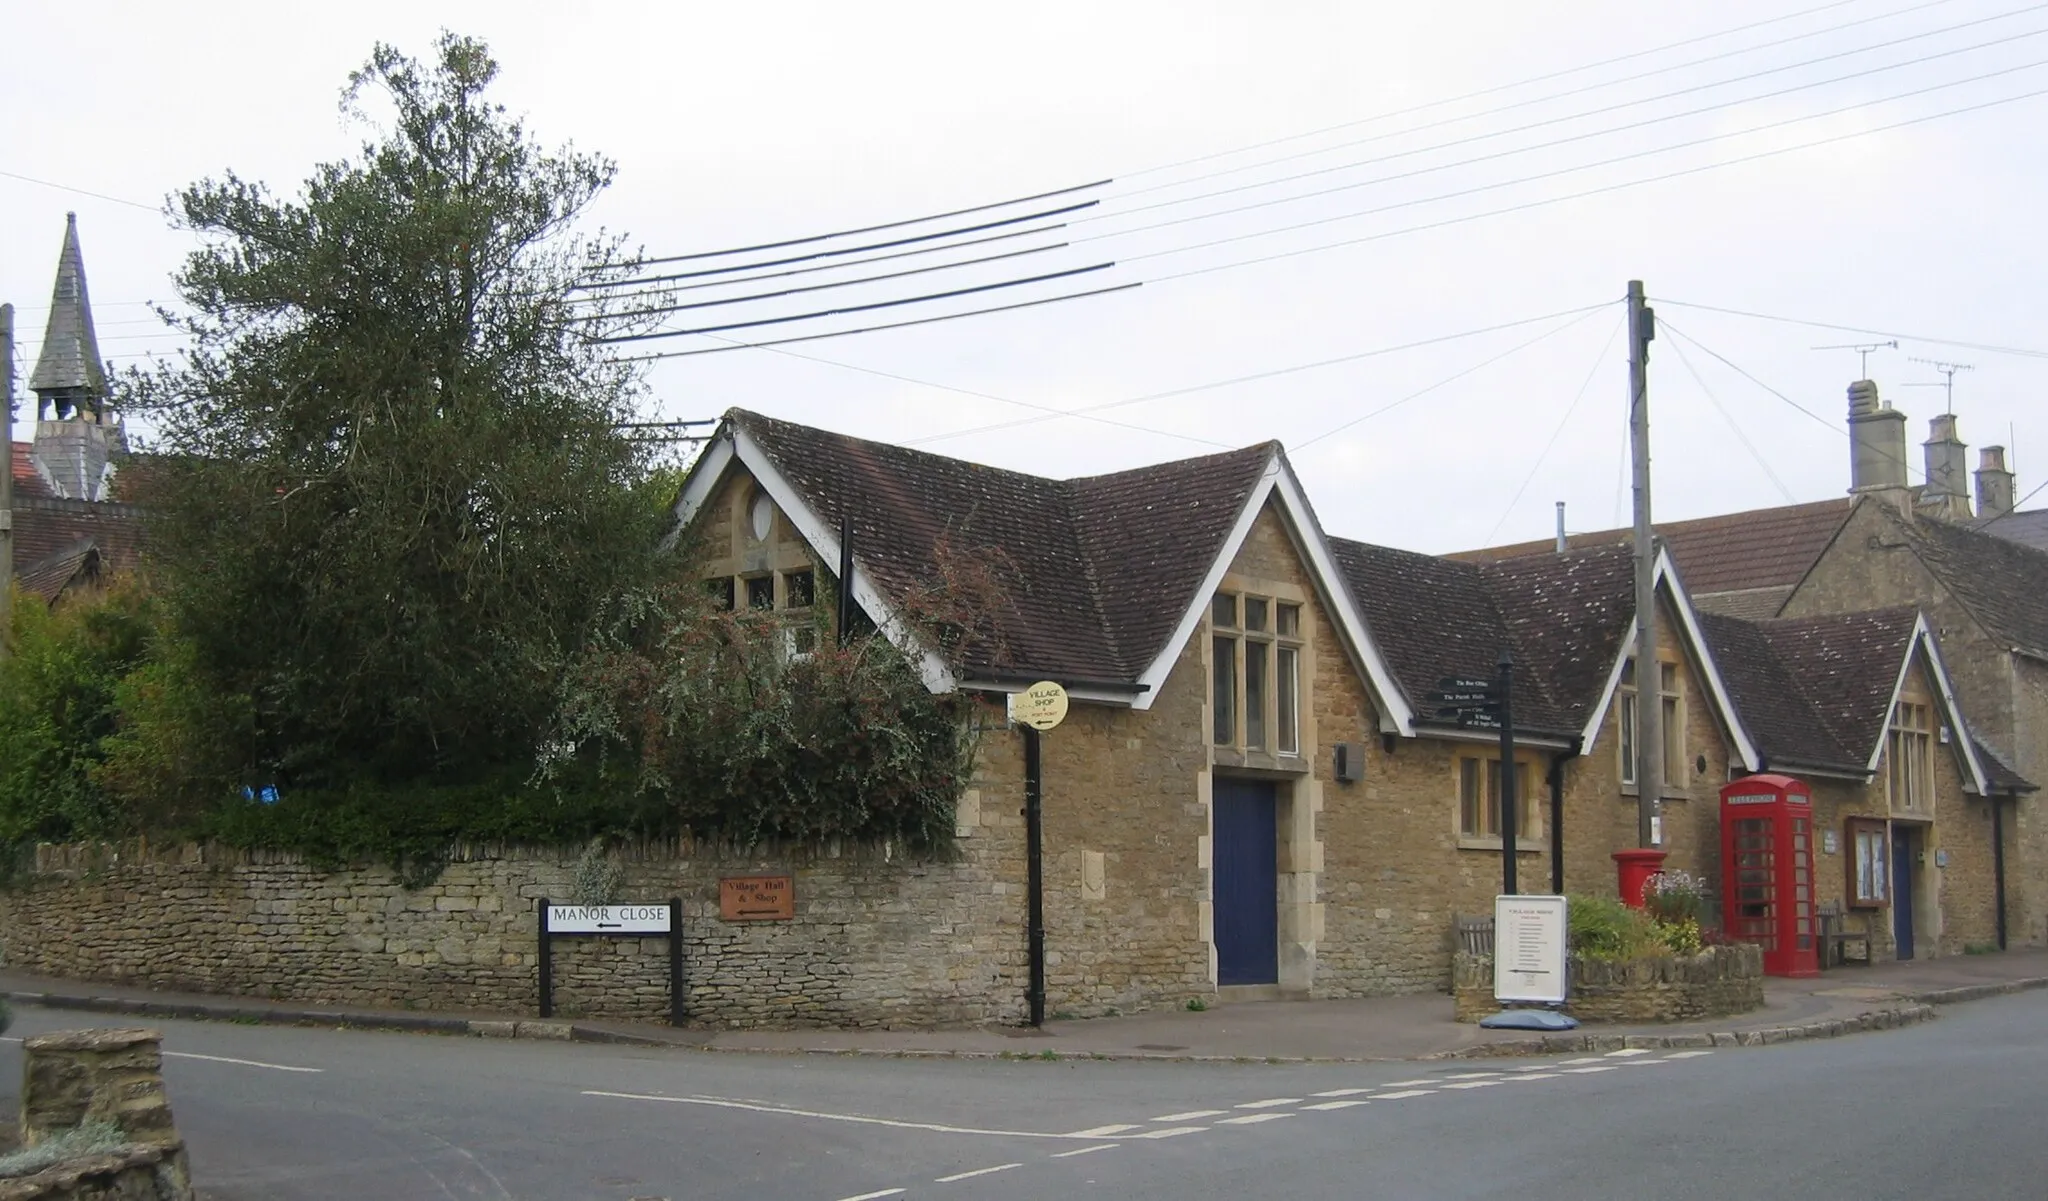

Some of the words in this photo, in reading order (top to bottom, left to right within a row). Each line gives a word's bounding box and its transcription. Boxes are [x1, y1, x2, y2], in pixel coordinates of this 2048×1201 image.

[1029, 689, 1061, 699] VILLAGE
[1034, 698, 1055, 707] SHOP
[728, 881, 760, 891] Village
[764, 880, 785, 890] Hall
[737, 894, 747, 902] &
[755, 893, 777, 904] Shop
[554, 907, 611, 921] MANOR
[619, 907, 665, 921] CLOSE
